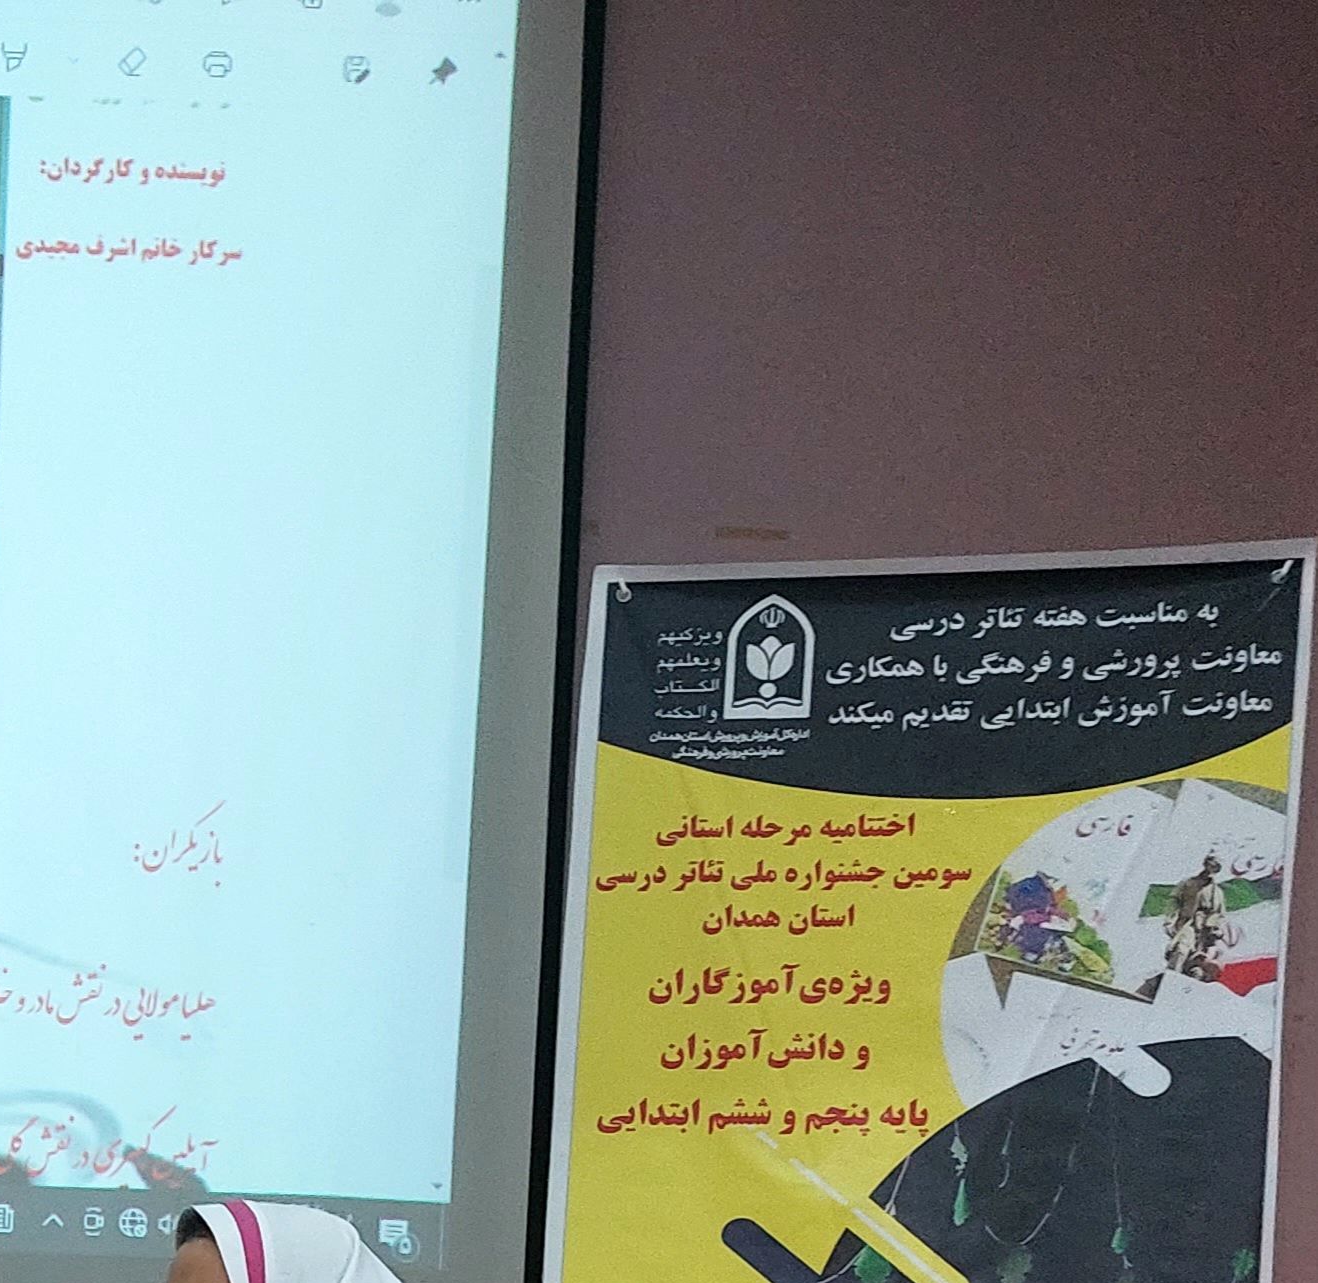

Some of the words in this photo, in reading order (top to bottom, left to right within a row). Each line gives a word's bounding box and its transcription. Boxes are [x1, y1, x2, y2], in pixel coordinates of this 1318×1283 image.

[140, 167, 150, 185] و
[155, 161, 226, 187] نویسنده
[86, 235, 136, 262] اشرف
[142, 238, 182, 262] خانم
[188, 239, 242, 265] سرکار
[889, 612, 965, 641] درسی
[973, 606, 1024, 639] تئاتر
[1033, 607, 1087, 628] هفته
[1096, 602, 1187, 630] مناسبت
[1198, 603, 1219, 630] به
[825, 656, 925, 686] همکاری
[933, 655, 948, 683] با
[955, 649, 1050, 684] فرهنگی
[1060, 656, 1076, 680] و
[1082, 647, 1182, 681] پرورشی
[1191, 643, 1283, 673] معاونت
[828, 700, 894, 731] میکند
[902, 700, 971, 731] تقدیم
[979, 696, 1070, 730] ابتدایی
[1077, 688, 1177, 727] آموزش
[1182, 690, 1273, 718] معاونت
[133, 799, 226, 887] بازیگران:
[656, 815, 733, 847] استانی
[740, 815, 812, 846] مرحله
[820, 813, 916, 844] اختتامیه
[595, 865, 668, 892] درسی
[672, 859, 725, 892] تئاتر
[730, 861, 777, 891] ملی
[784, 859, 886, 891] جشنواره
[893, 865, 973, 891] سومین
[702, 904, 781, 936] همدان
[788, 904, 855, 936] استان
[56, 962, 108, 1026] نقش
[648, 964, 800, 1005] آموزگاران
[16, 995, 27, 1013] و
[104, 996, 121, 1017] در
[852, 1045, 871, 1070] و
[596, 1098, 701, 1134] ابتدایی
[708, 1098, 773, 1135] ششم
[778, 1109, 797, 1135] و
[804, 1103, 871, 1137] پنجم
[880, 1098, 930, 1138] پایه
[25, 1114, 76, 1179] نقش
[73, 1150, 90, 1169] در
